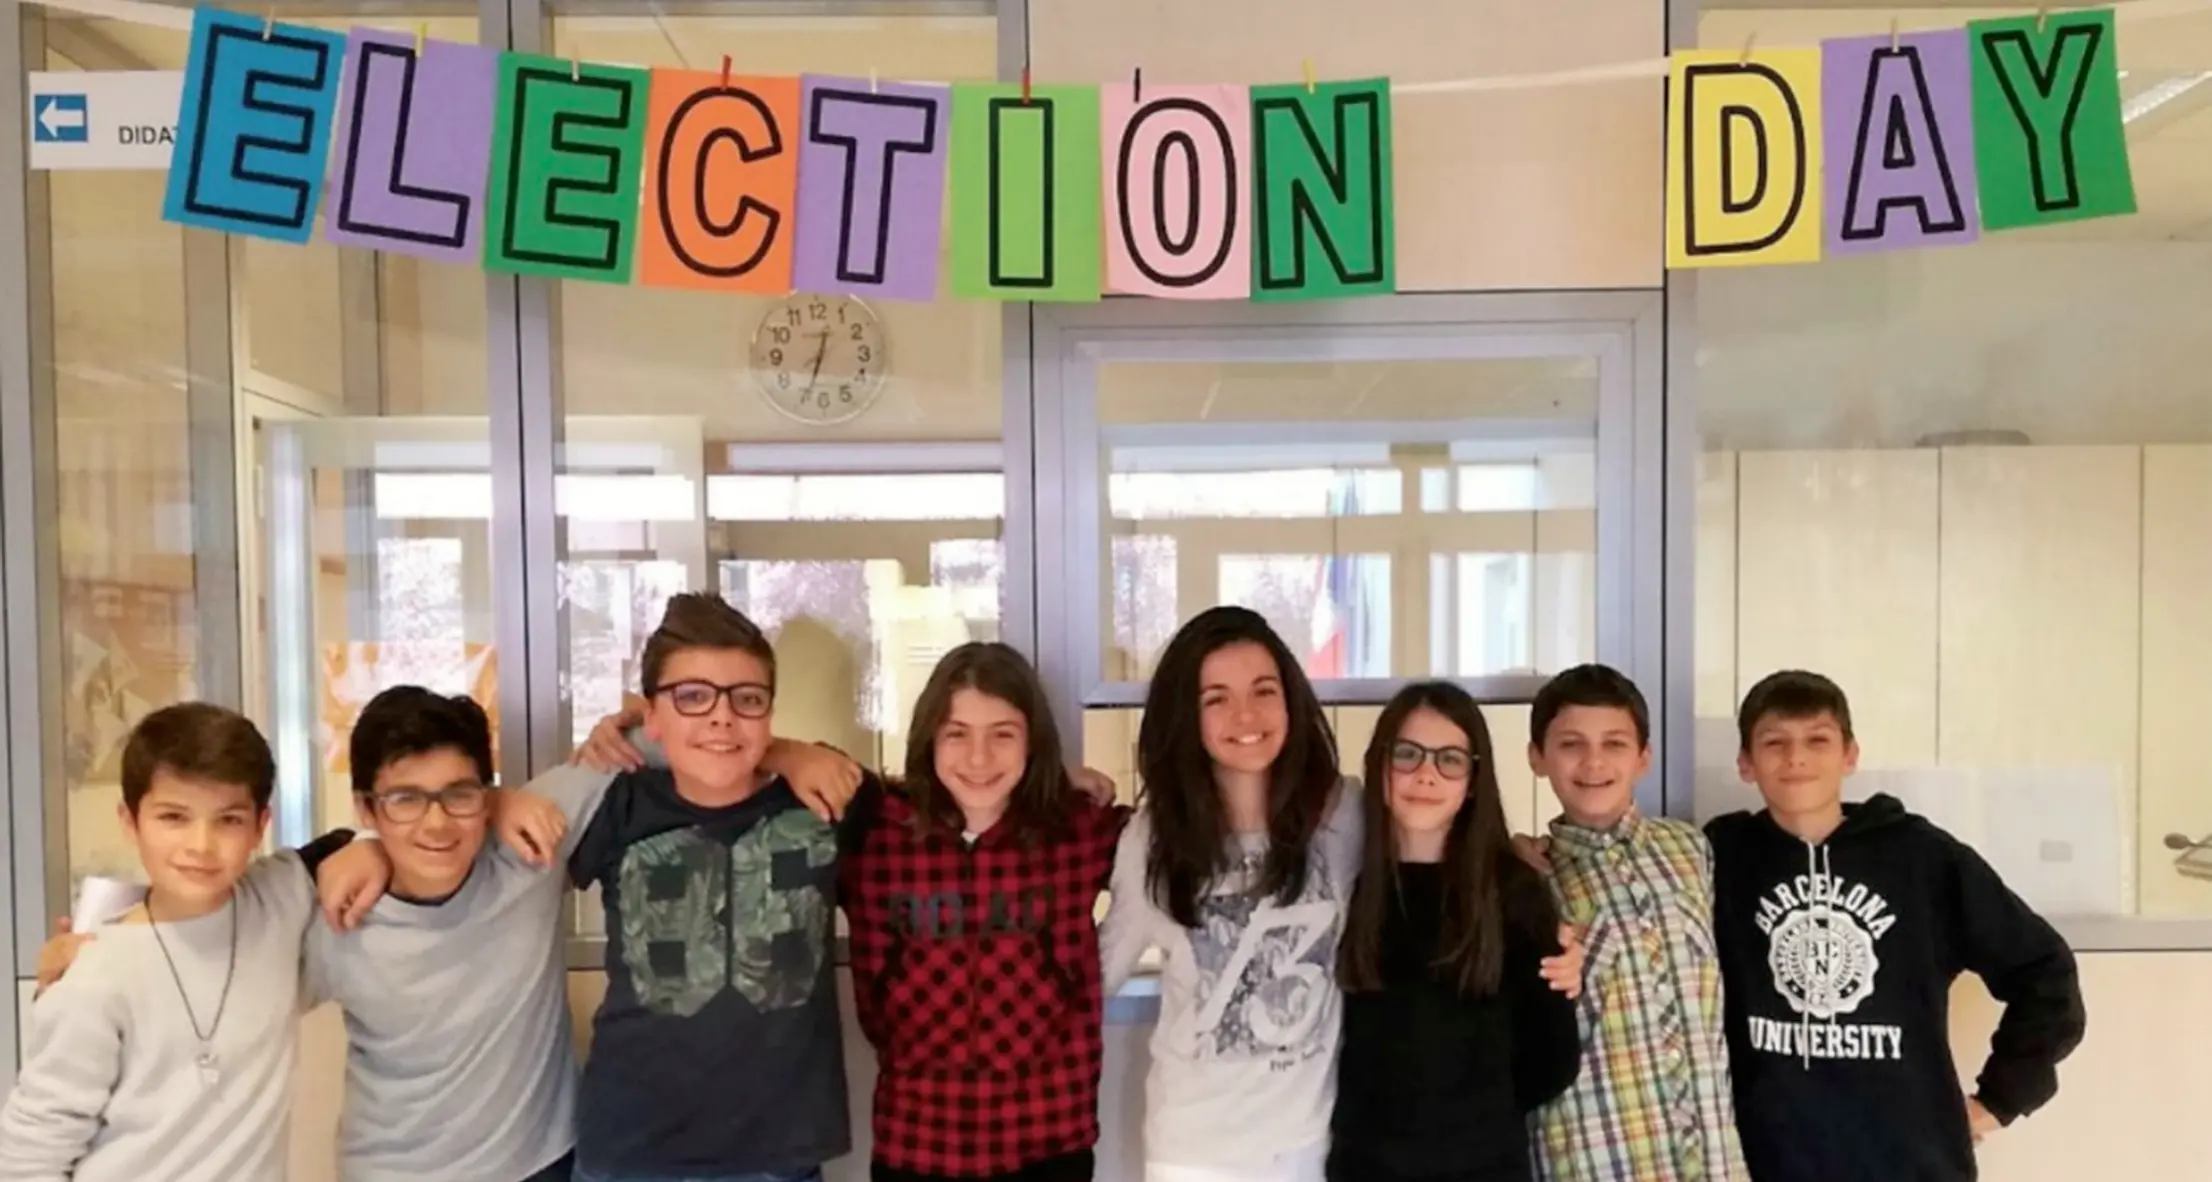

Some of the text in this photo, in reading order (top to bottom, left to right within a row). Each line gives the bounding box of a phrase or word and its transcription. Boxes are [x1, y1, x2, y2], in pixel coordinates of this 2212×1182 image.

[184, 23, 2103, 290] ELECTION DAY
[787, 307, 802, 326] 11
[808, 302, 827, 320] 12
[771, 326, 791, 344] 10
[850, 323, 863, 340] 2
[769, 348, 783, 366] 9
[857, 345, 871, 363] 3
[839, 384, 853, 403] 5
[1754, 873, 1897, 940] BARCELONA
[1748, 1015, 1902, 1060] UNIVERSITY
